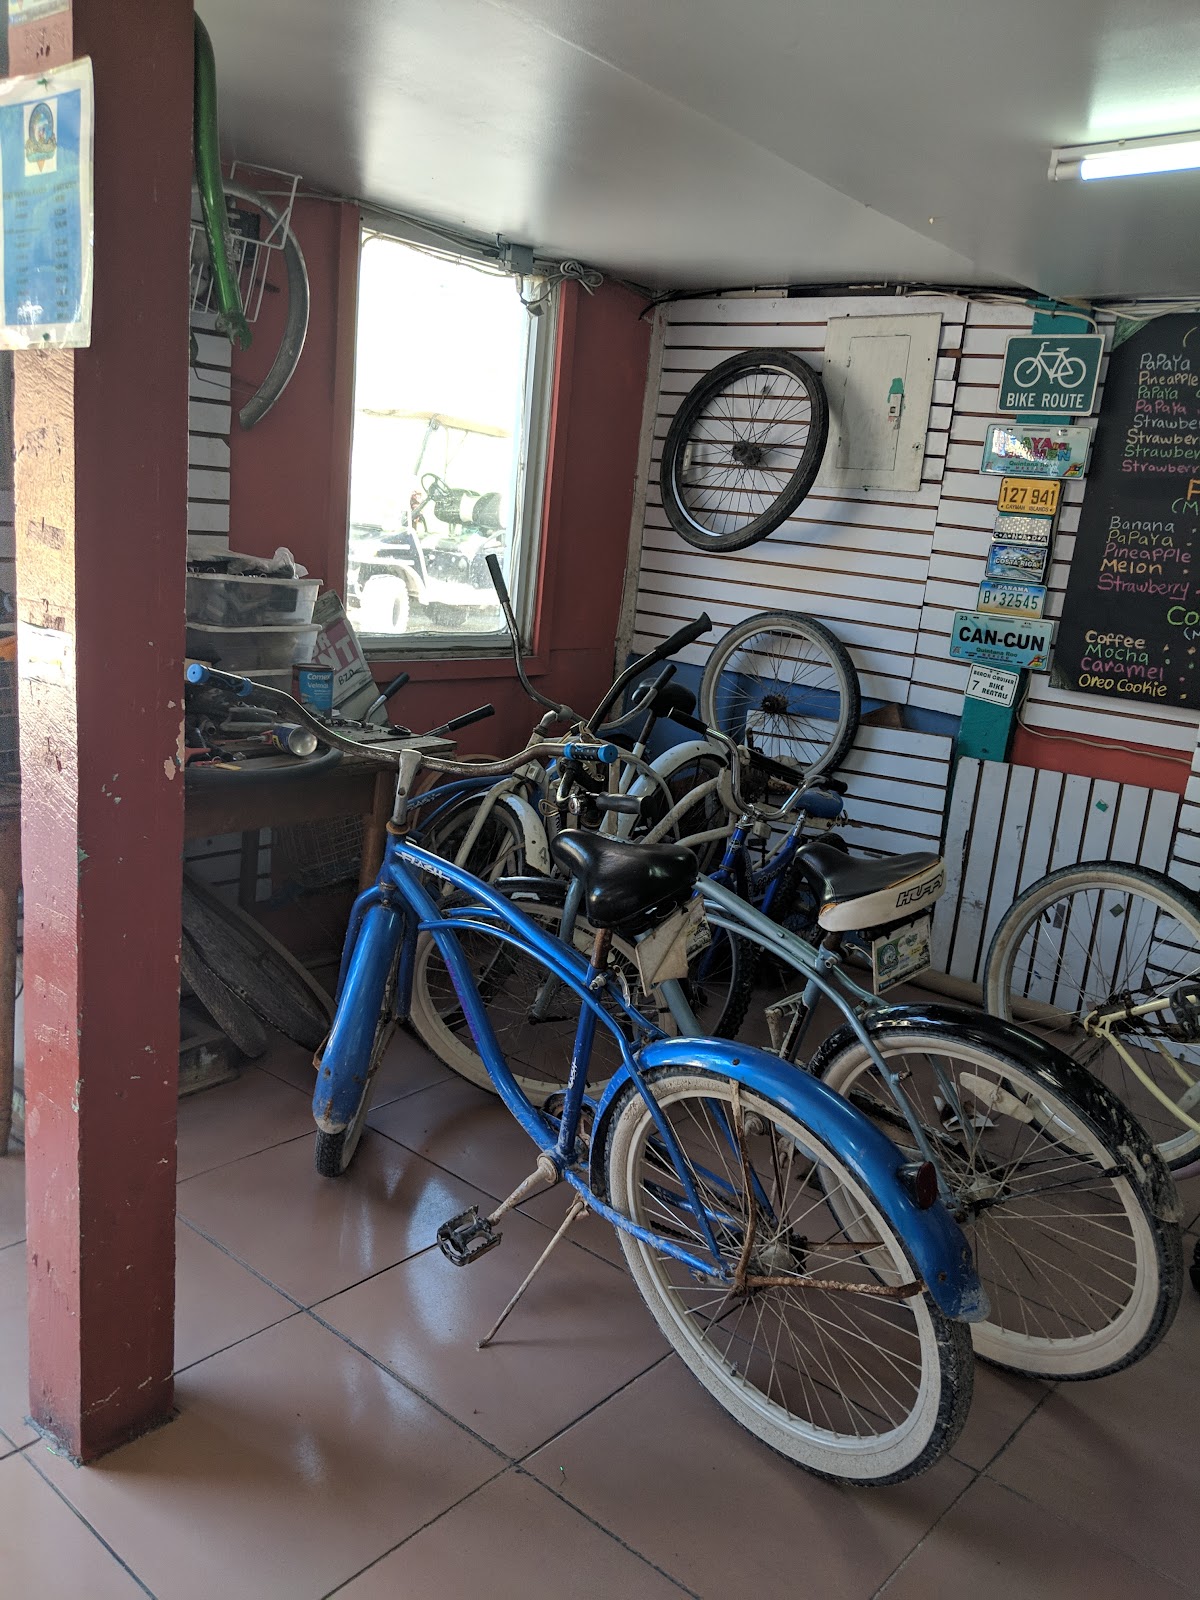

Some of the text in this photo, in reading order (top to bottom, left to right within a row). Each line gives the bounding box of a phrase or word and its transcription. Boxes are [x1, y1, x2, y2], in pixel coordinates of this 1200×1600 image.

[1006, 392, 1084, 408] BIKE ROUTE
[1133, 413, 1200, 430] Strawbe
[1003, 486, 1056, 505] 127 941
[995, 556, 1038, 568] COSTA RICA
[997, 584, 1029, 593] PANAMA
[958, 626, 1045, 652] CAN-CUN
[1085, 629, 1146, 649] Coffee
[1081, 657, 1164, 681] Caramel
[972, 680, 1005, 691] 7 BIKE
